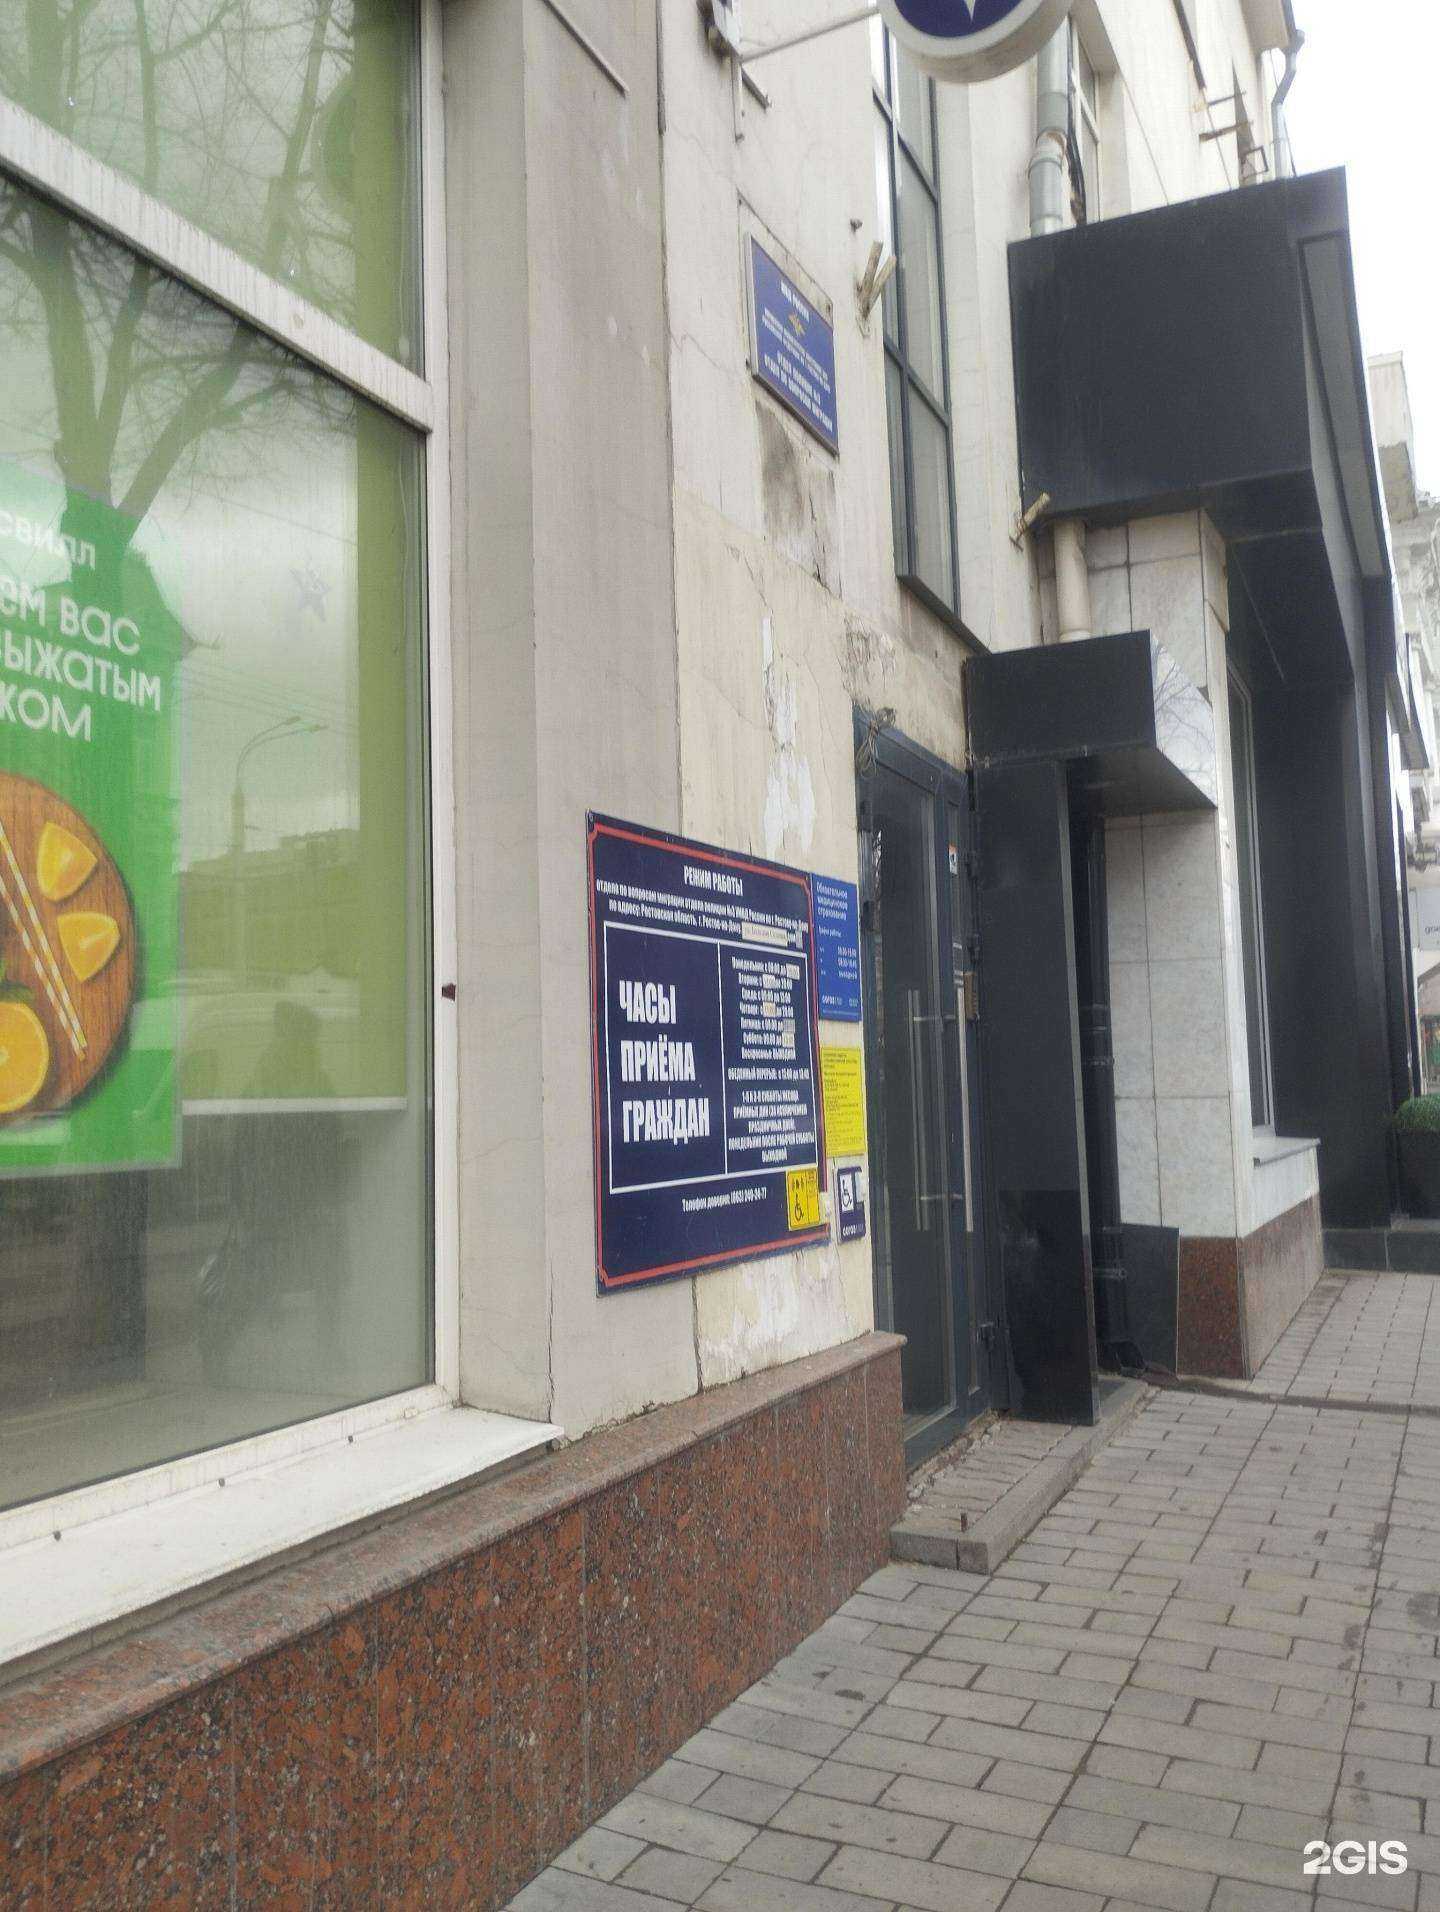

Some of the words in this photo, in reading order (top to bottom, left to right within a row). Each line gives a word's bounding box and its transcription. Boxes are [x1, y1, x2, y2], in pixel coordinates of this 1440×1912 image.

[684, 864, 712, 890] РЕЖИМ
[713, 871, 743, 897] РАБОТЫ
[619, 979, 677, 1025] ЧАСЫ
[621, 1033, 696, 1082] ПРИЁМА
[623, 1098, 710, 1149] ГРАЖДАН
